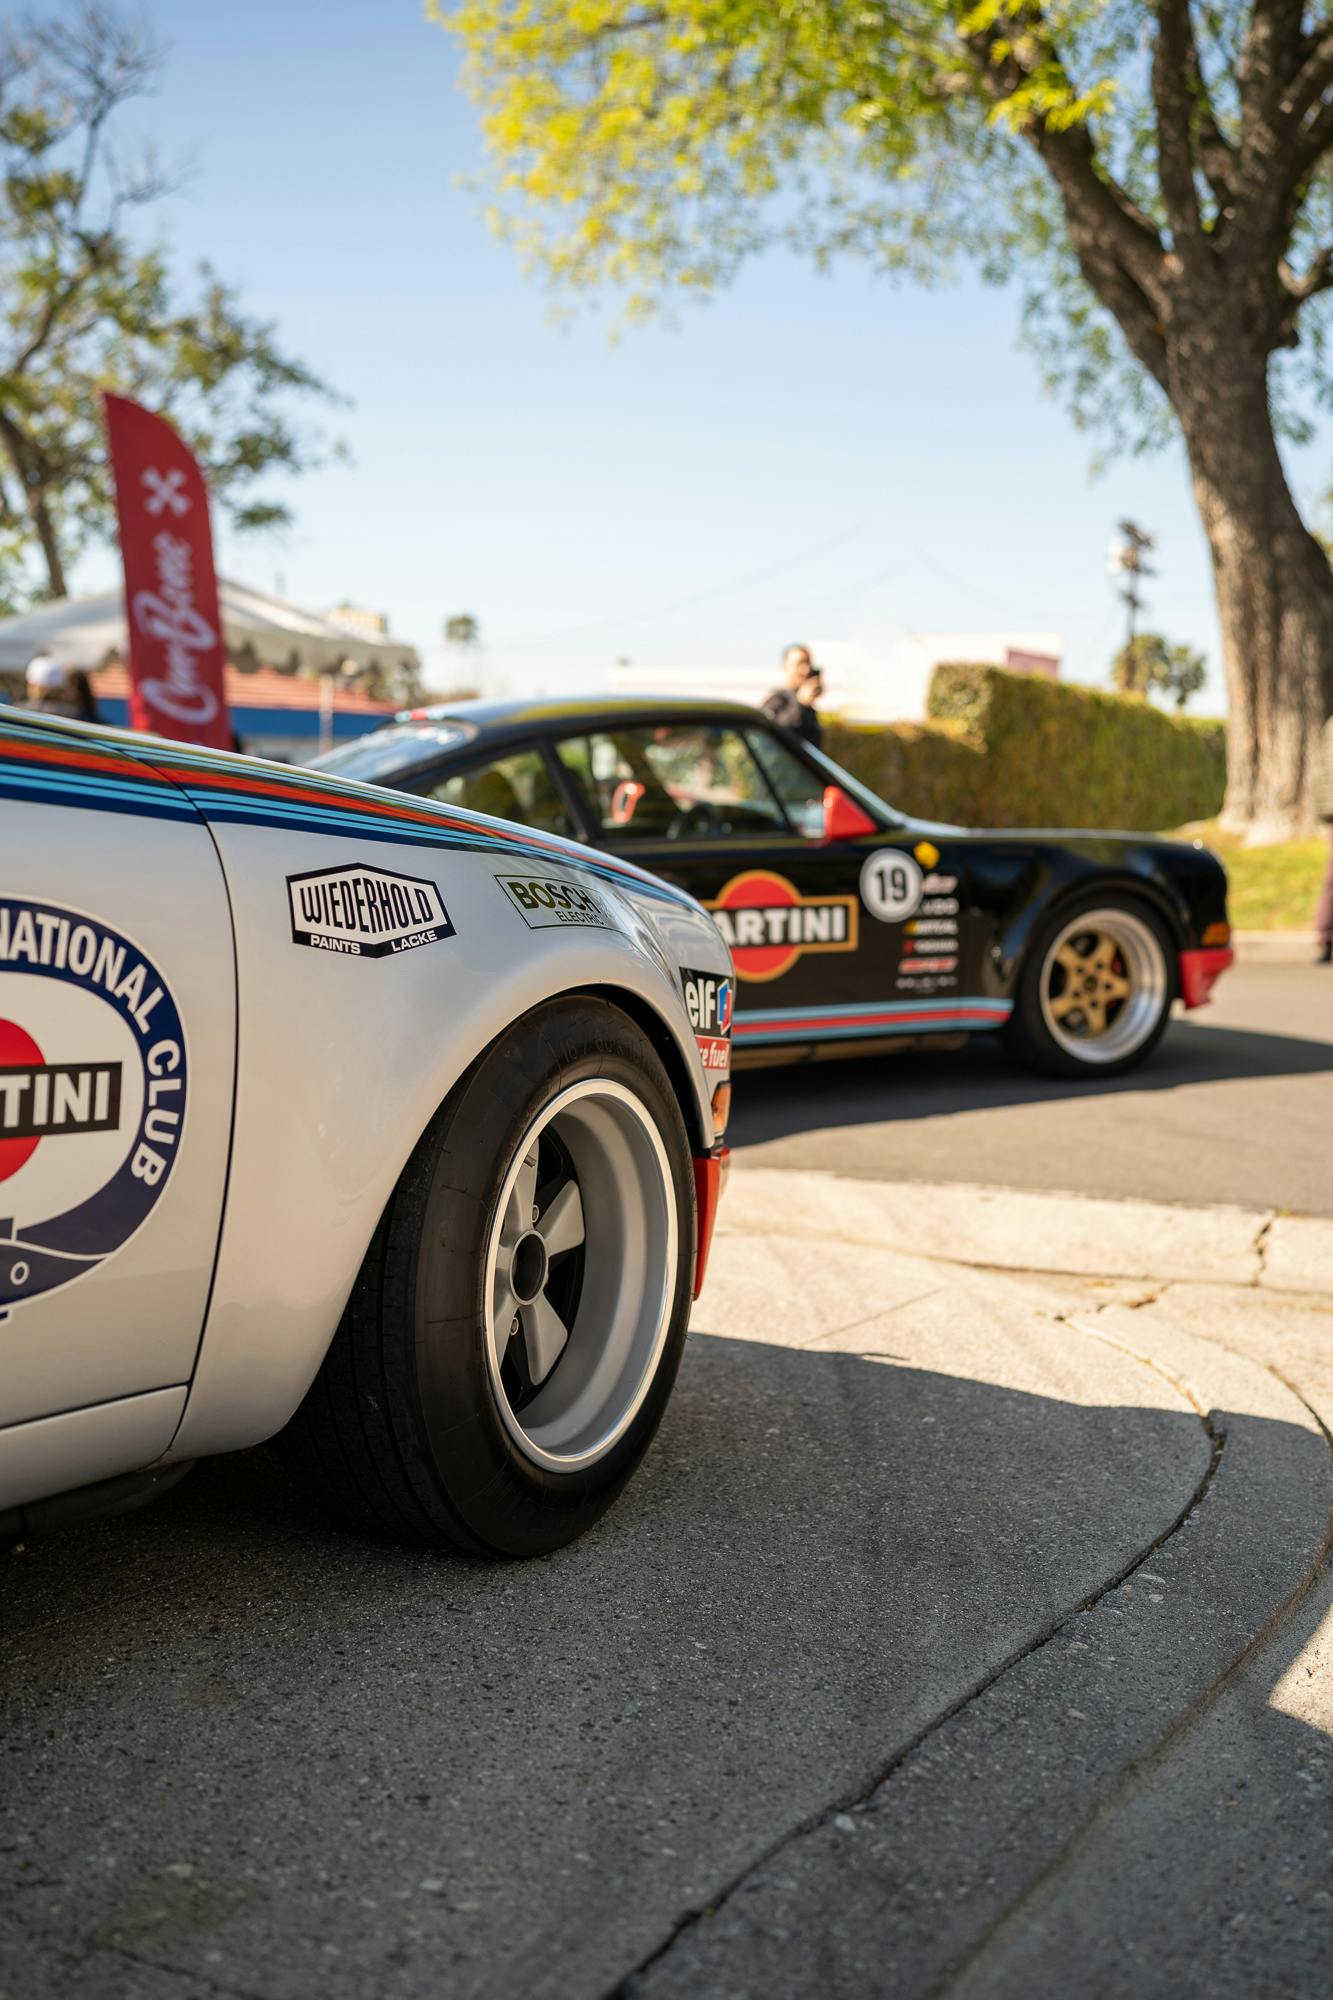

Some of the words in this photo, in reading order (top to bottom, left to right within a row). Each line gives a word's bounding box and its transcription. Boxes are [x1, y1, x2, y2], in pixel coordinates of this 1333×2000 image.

[299, 877, 434, 934] WIEDERHOLD
[507, 882, 601, 914] BOSCH
[875, 868, 908, 904] 19
[310, 933, 361, 955] PAINTS
[391, 930, 438, 953] LACKE
[685, 978, 716, 1029] elf
[708, 1041, 730, 1068] fuel
[0, 1071, 110, 1128] TINI
[130, 1039, 182, 1186] CLUB
